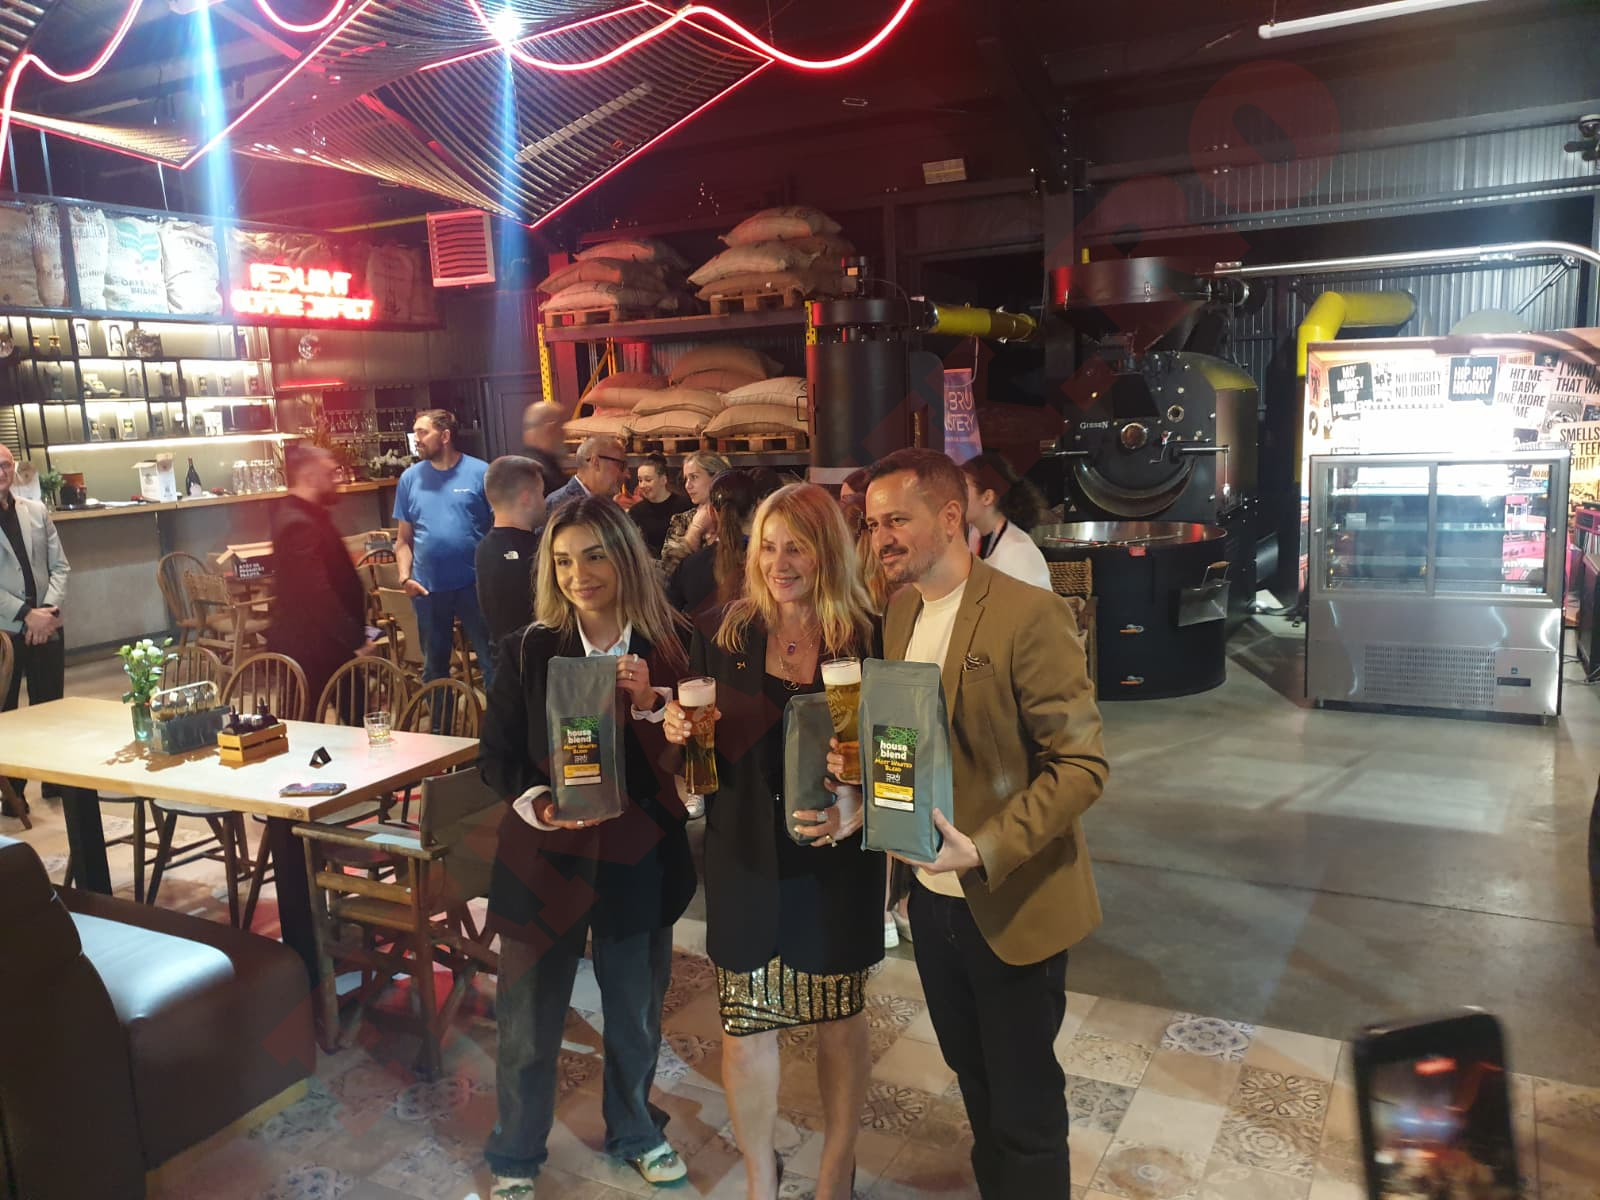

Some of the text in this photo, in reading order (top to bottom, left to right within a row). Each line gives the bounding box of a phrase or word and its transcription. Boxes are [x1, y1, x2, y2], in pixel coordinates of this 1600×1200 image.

[1454, 366, 1493, 380] HIP HOP
[1510, 368, 1544, 381] HIT ME
[1560, 361, 1564, 376] I
[1396, 374, 1407, 383] NO
[1410, 370, 1442, 383] DIGGITY
[1337, 376, 1364, 392] MONEY
[1395, 384, 1441, 398] NO DOUBT
[1452, 379, 1492, 395] HOORAY
[1512, 381, 1537, 393] BABY
[1556, 377, 1583, 393] THAT
[1497, 392, 1516, 404] ONE
[1517, 393, 1546, 408] MORE
[1560, 427, 1600, 442] SMELLS
[1570, 456, 1595, 471] PIRIT
[567, 729, 592, 737] house
[568, 736, 592, 744] blend
[880, 740, 908, 751] house
[880, 750, 907, 760] blend
